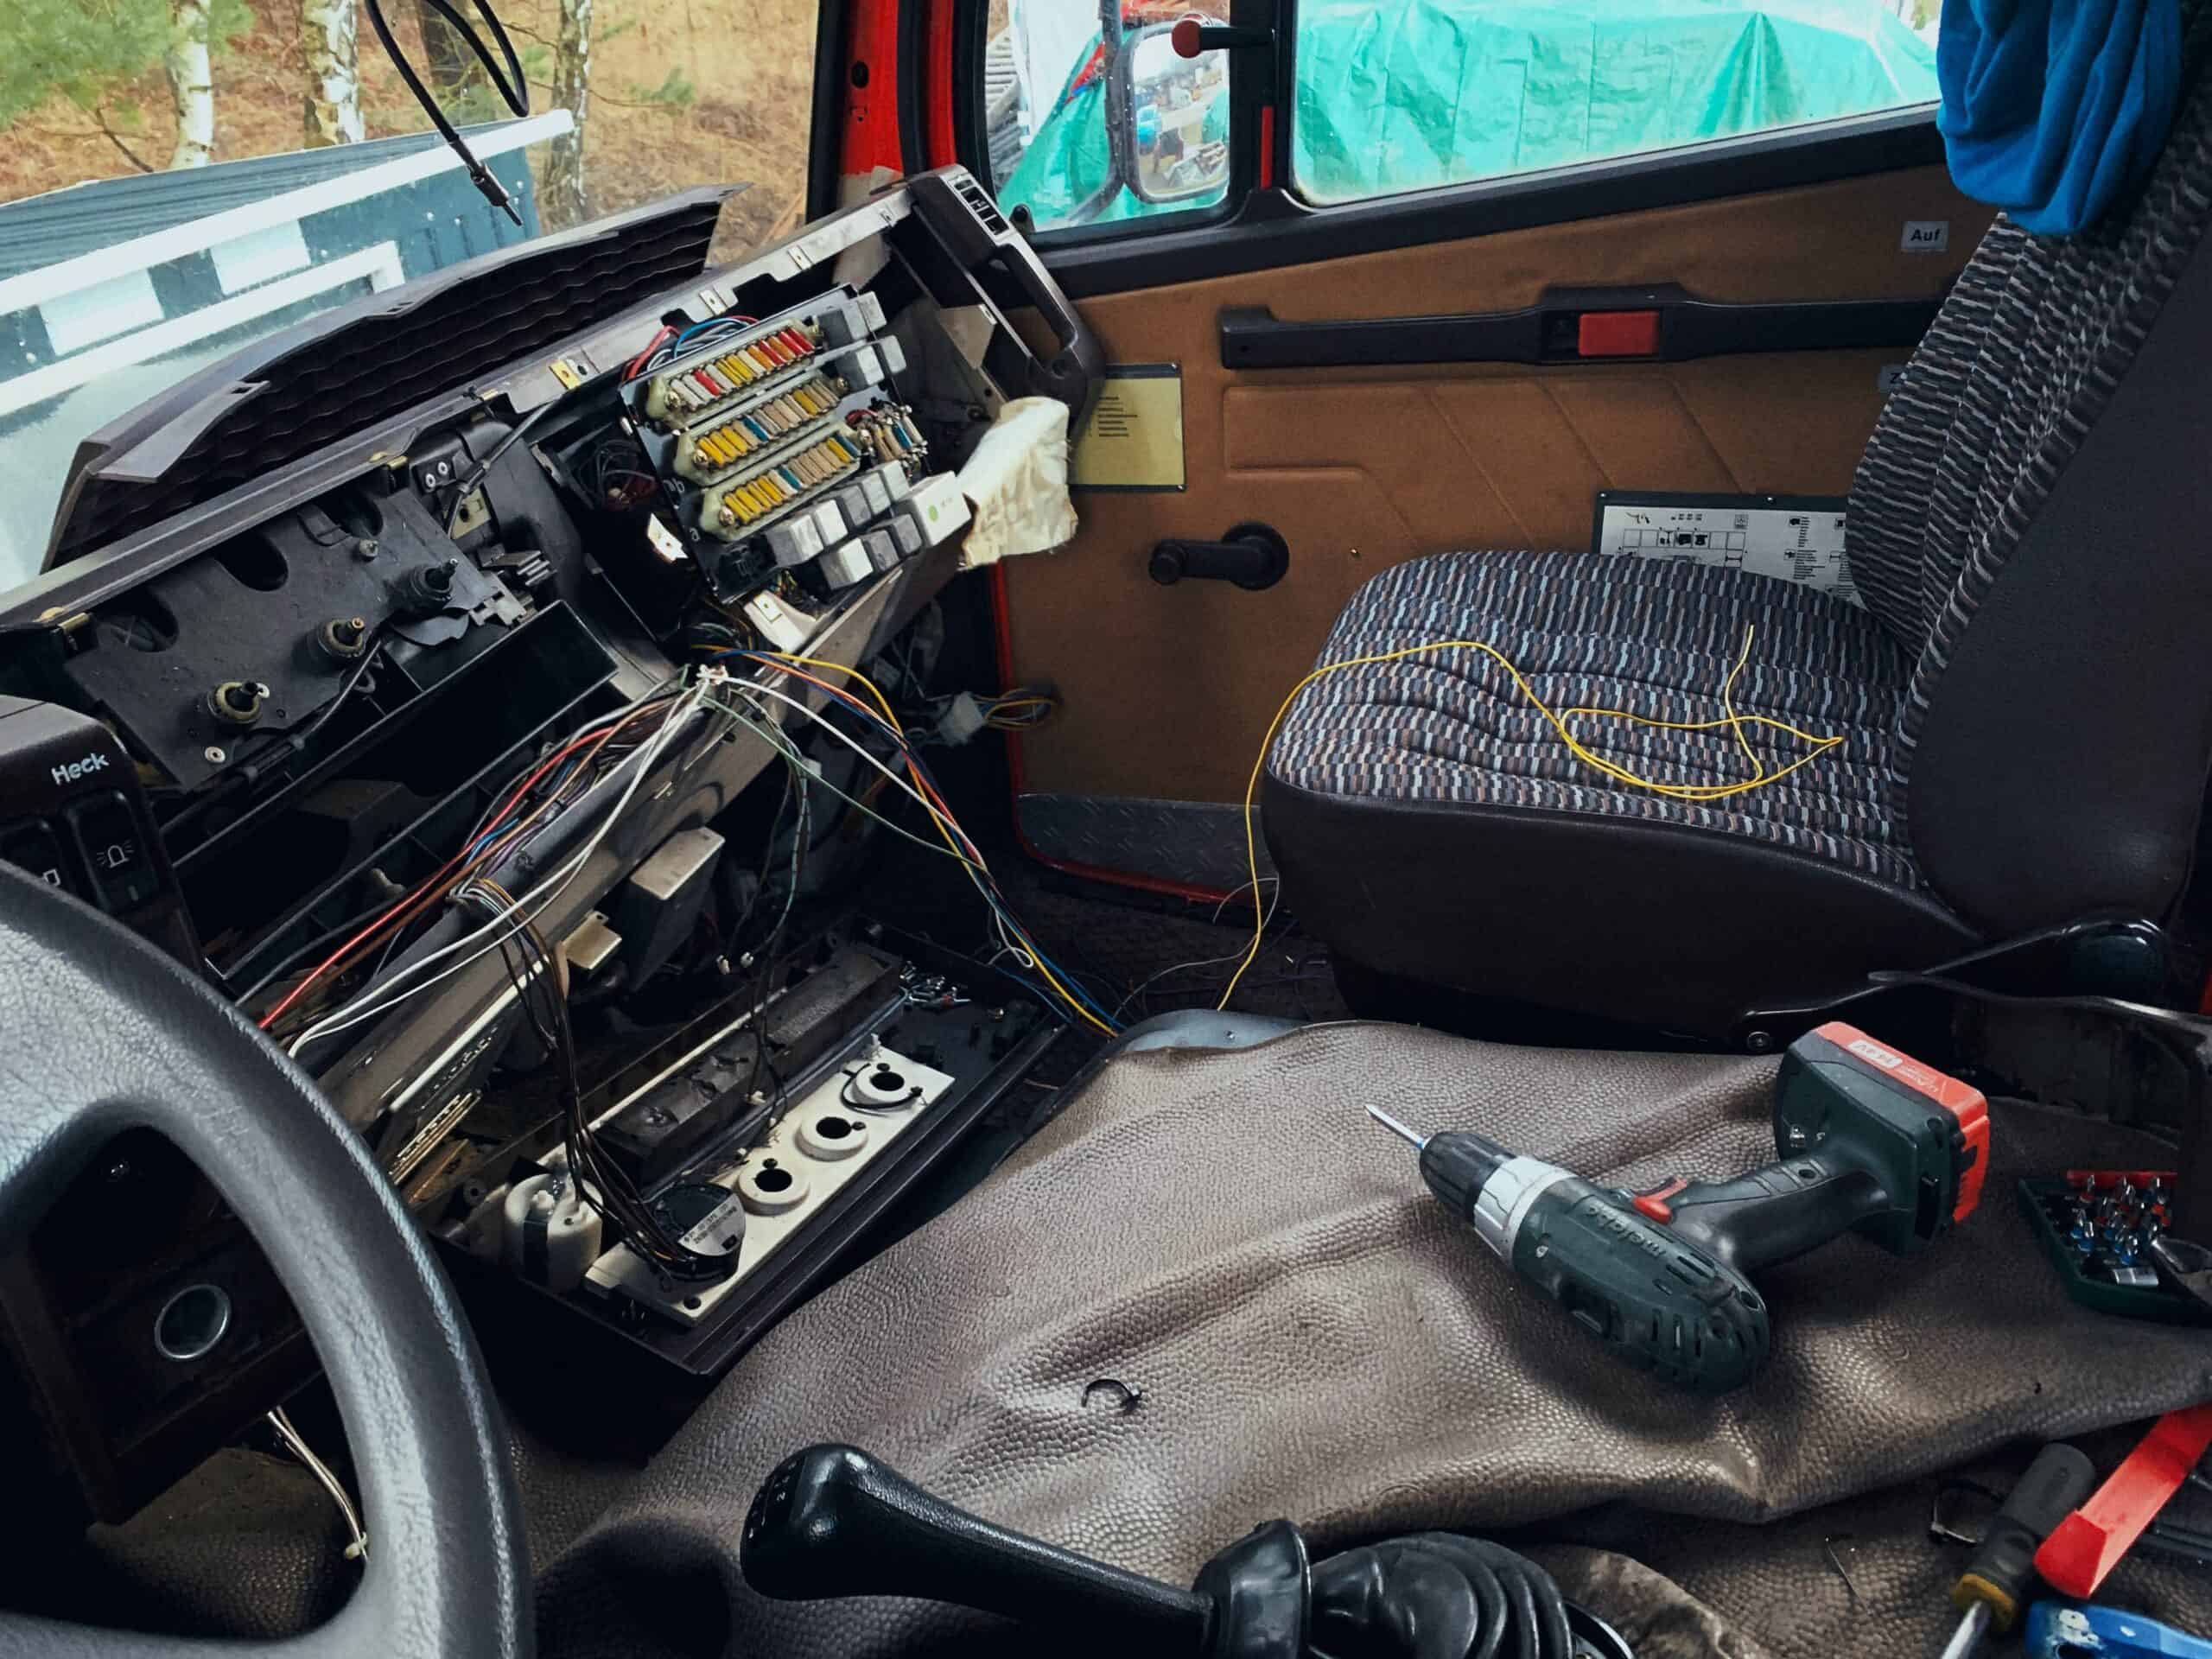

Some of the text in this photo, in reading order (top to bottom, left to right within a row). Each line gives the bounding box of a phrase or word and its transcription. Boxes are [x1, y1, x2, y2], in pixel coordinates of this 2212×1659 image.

[1910, 228, 1941, 242] Auf
[51, 753, 110, 785] Heck
[1585, 1205, 1667, 1258] metabo
